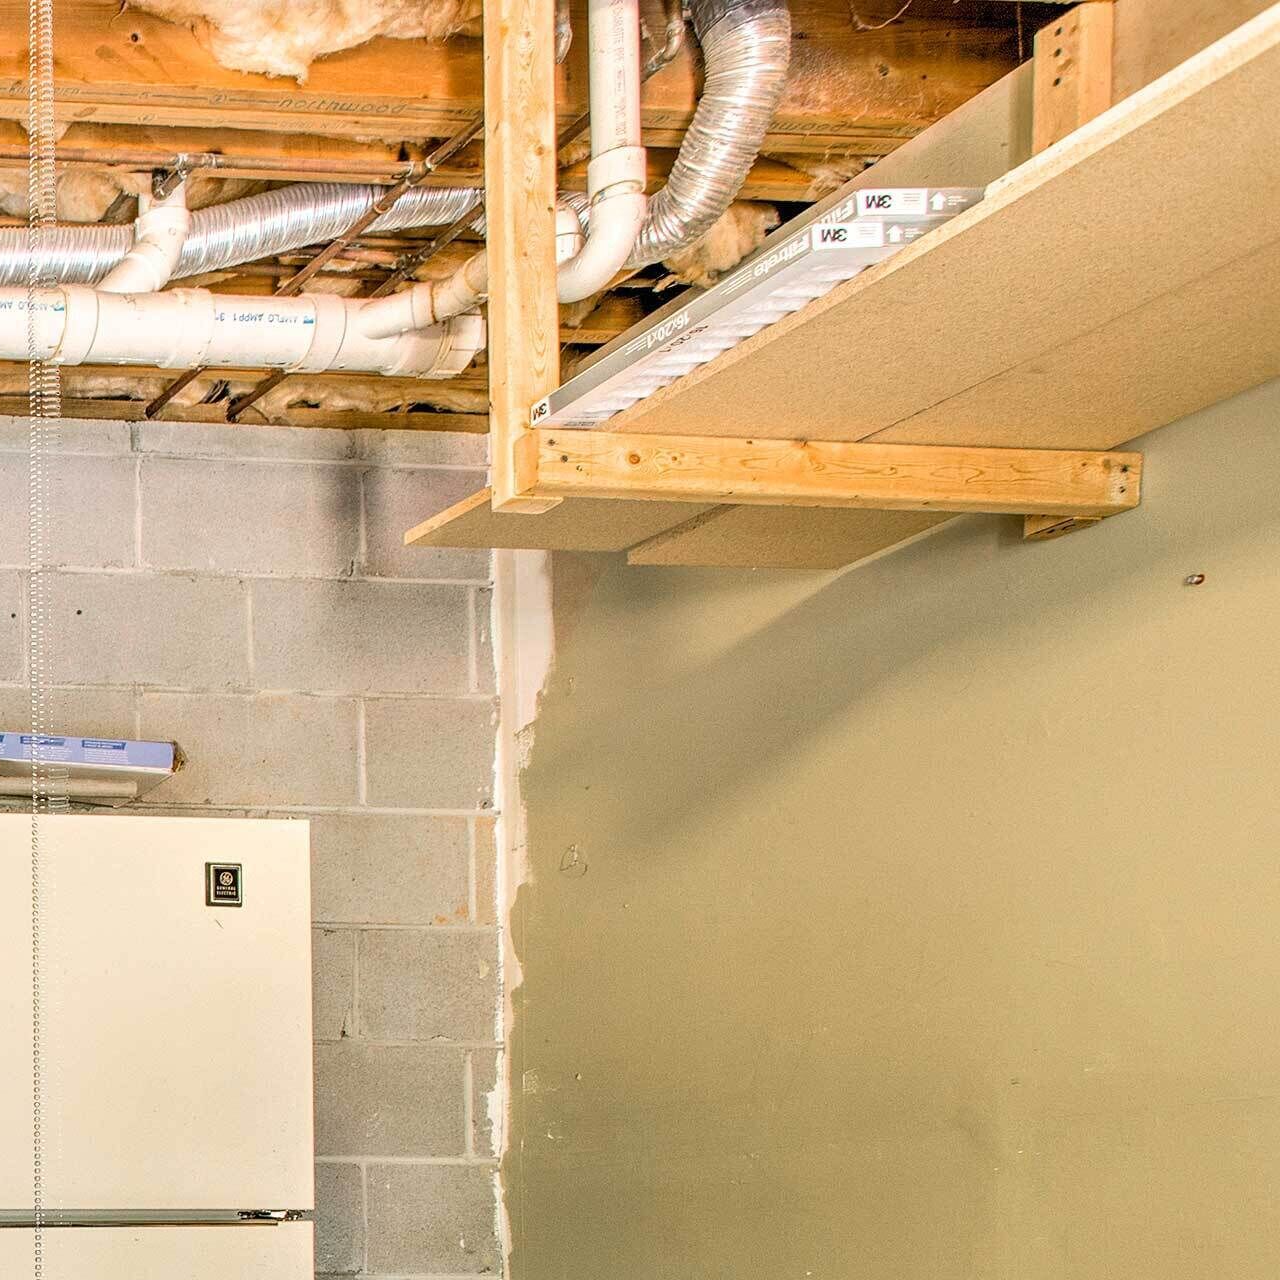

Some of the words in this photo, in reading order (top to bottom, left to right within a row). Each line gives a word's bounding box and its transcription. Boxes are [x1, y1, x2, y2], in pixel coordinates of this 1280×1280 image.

[278, 96, 407, 115] northwood
[865, 194, 892, 209] 3M
[820, 228, 848, 243] 3M
[753, 235, 808, 279] Filtrete
[647, 311, 690, 348] 16x20x1
[533, 402, 547, 420] 3M
